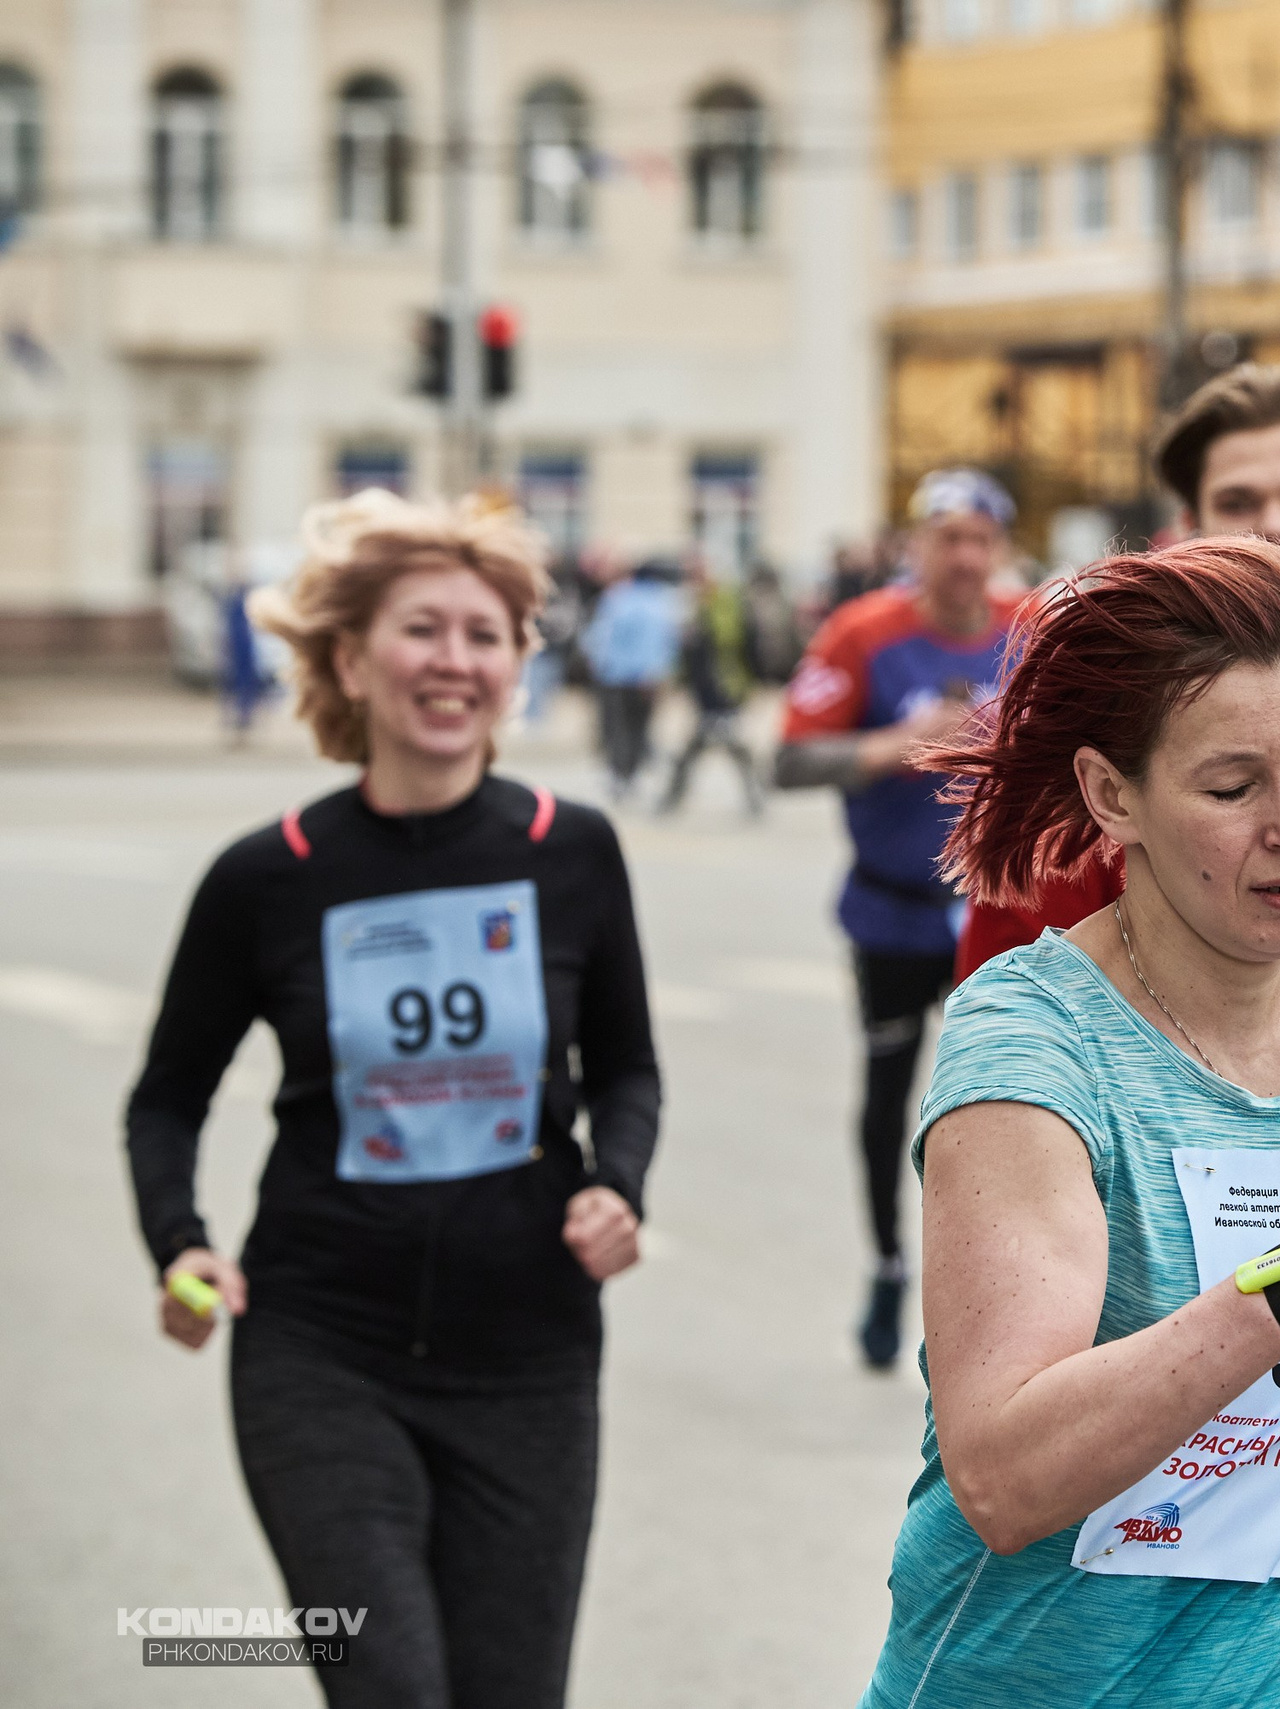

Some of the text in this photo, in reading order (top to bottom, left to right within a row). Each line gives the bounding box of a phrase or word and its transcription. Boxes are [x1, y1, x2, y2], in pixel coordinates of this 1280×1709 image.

[388, 980, 486, 1055] 99
[1228, 1186, 1279, 1199] Федерация
[1219, 1202, 1249, 1212] легкой
[1214, 1216, 1267, 1229] Ивановской
[1146, 1542, 1180, 1550] ИВАНОВО
